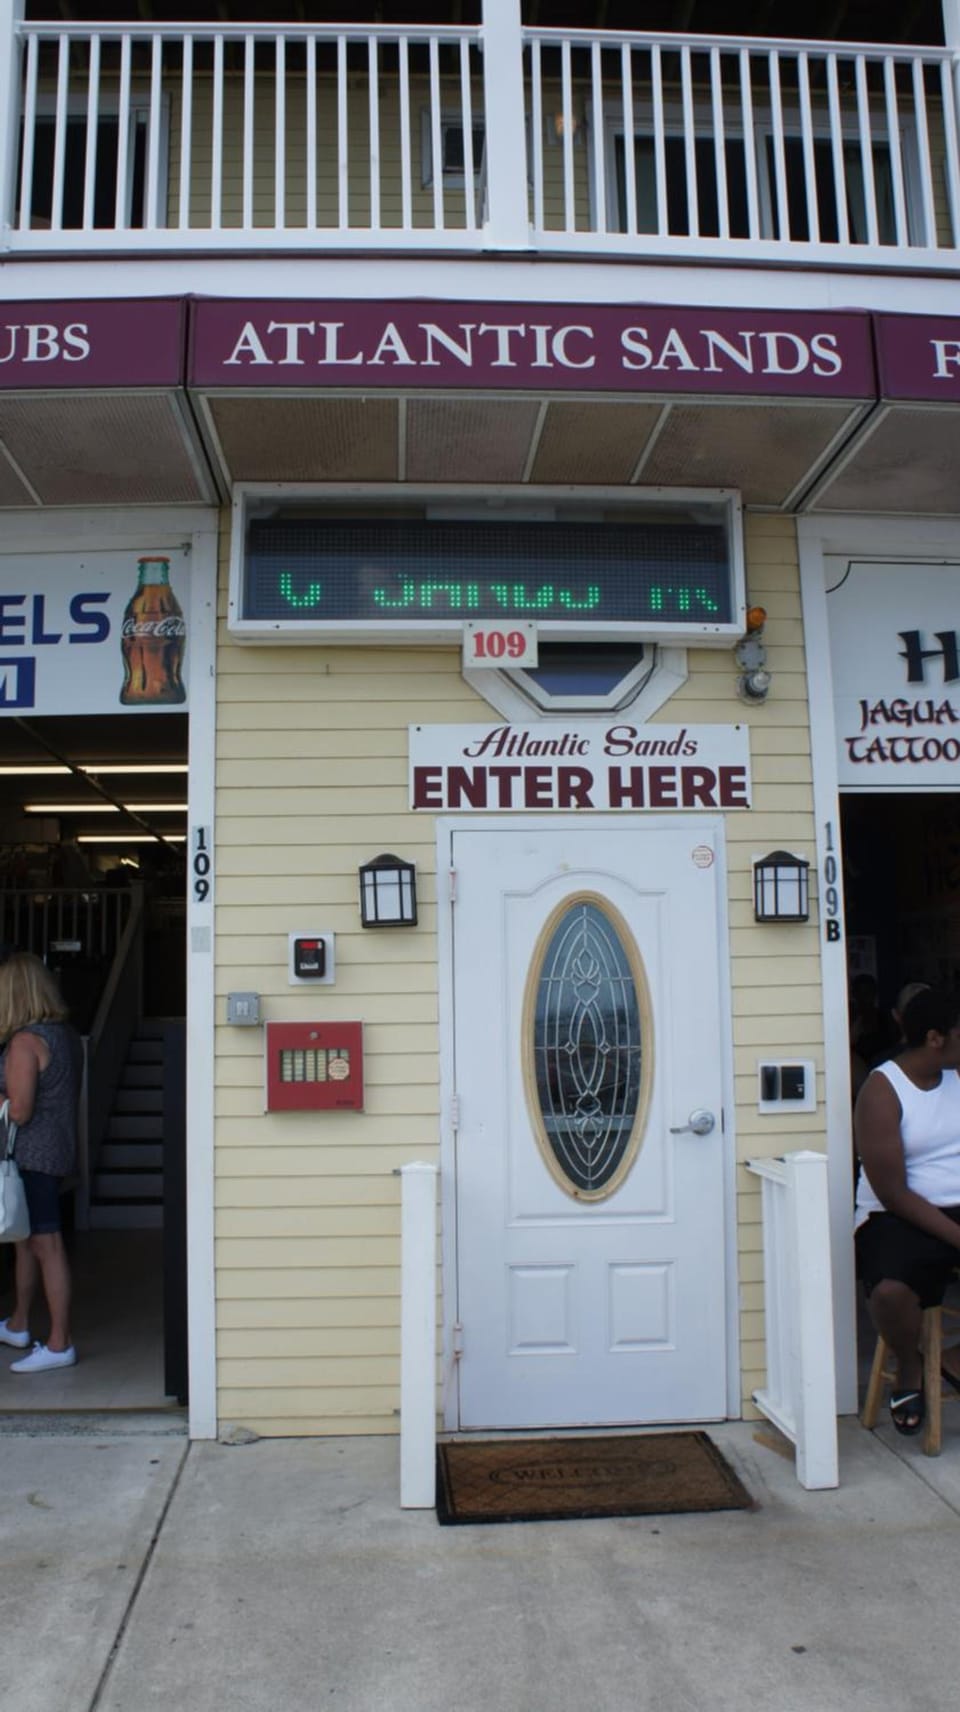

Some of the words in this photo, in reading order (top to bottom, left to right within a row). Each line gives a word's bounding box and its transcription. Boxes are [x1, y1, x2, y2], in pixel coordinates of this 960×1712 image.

[223, 320, 596, 369] ATLANTIC
[620, 327, 843, 377] SANDS
[0, 591, 111, 646] ELS
[472, 631, 527, 658] 109
[858, 698, 960, 732] JAGUA
[463, 725, 591, 758] Atlantic
[603, 725, 699, 757] Sands
[844, 736, 960, 764] TATTOO
[413, 766, 595, 809] ENTER
[608, 766, 748, 809] HERE
[193, 827, 210, 903] 109
